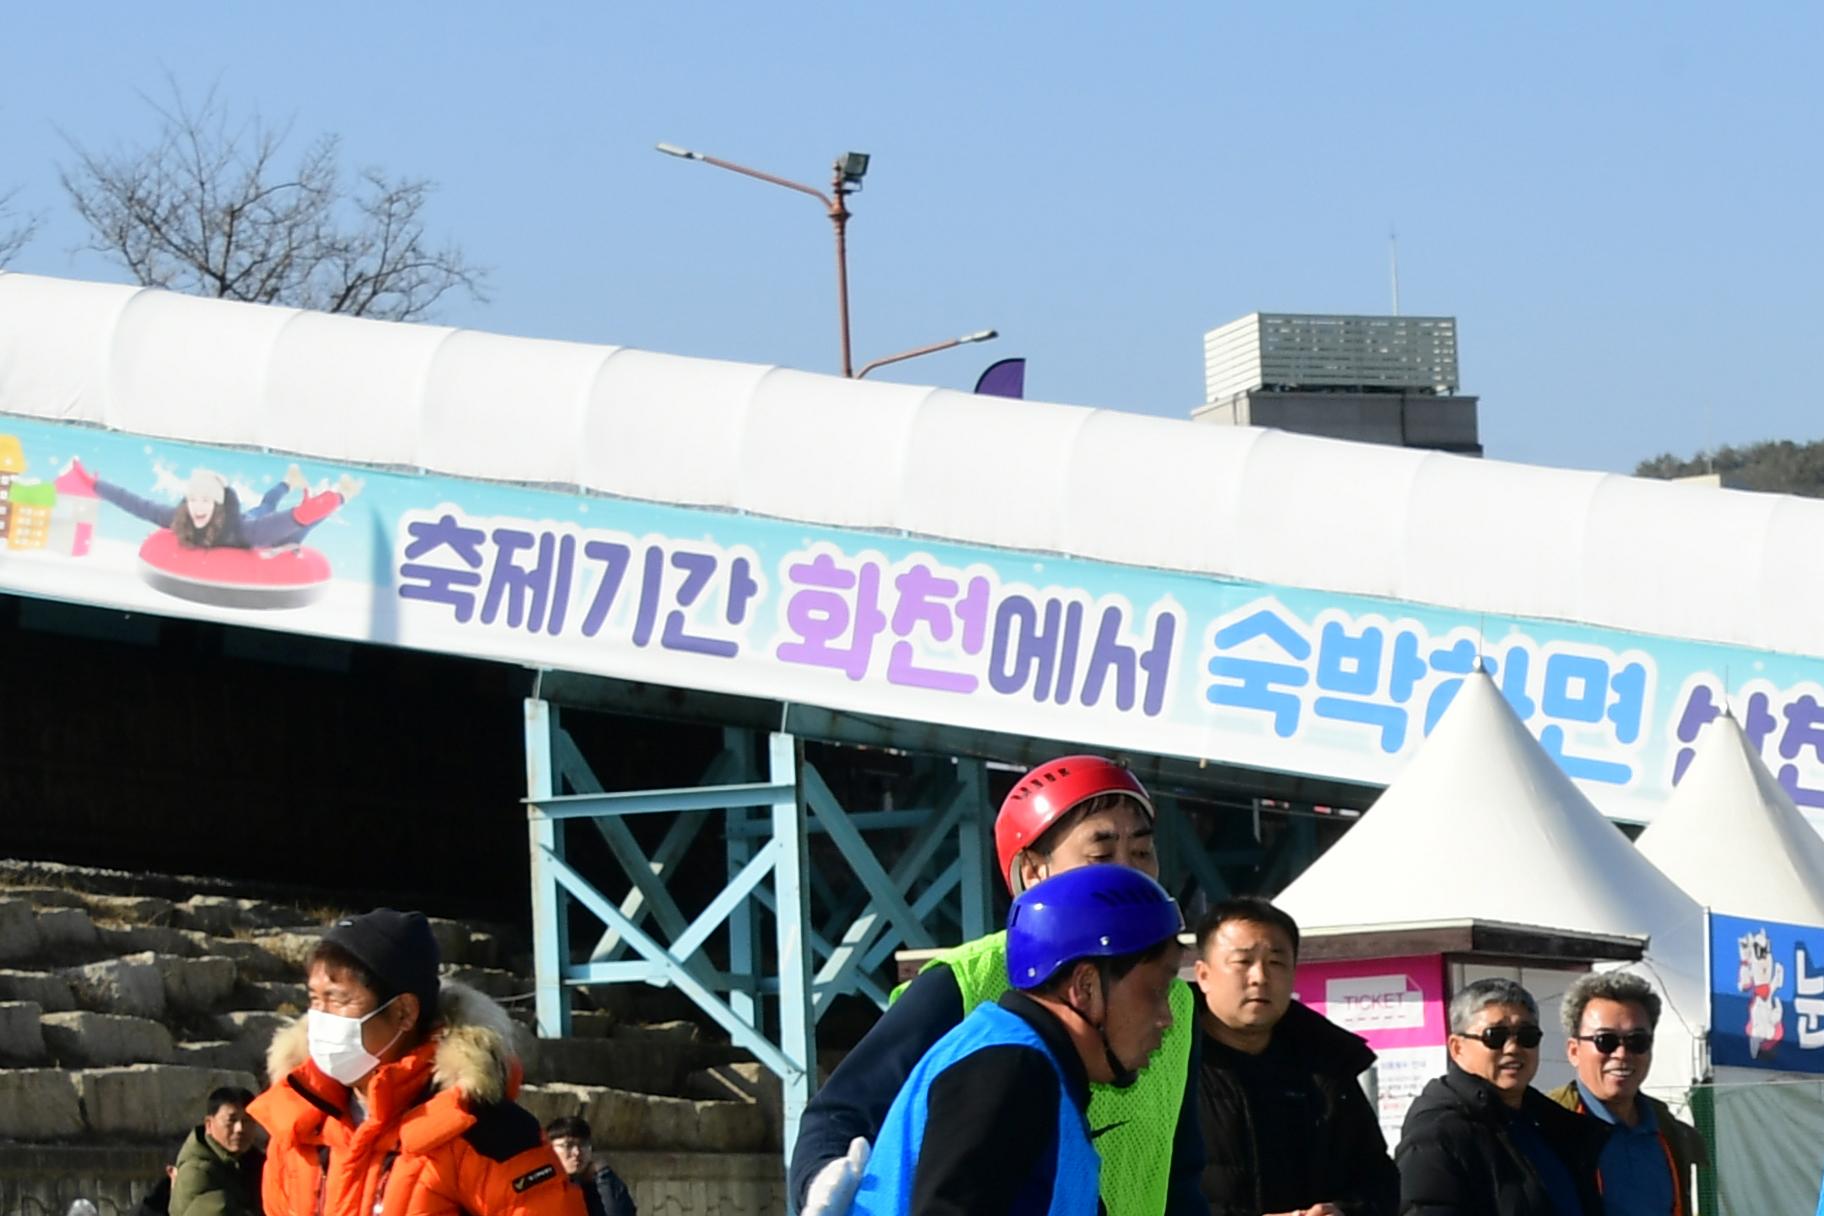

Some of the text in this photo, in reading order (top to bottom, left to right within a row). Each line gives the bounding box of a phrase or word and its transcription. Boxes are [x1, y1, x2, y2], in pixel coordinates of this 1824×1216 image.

[398, 514, 759, 659] 축제기간
[777, 552, 1174, 718] 화천에서
[1344, 992, 1405, 1011] TICKET
